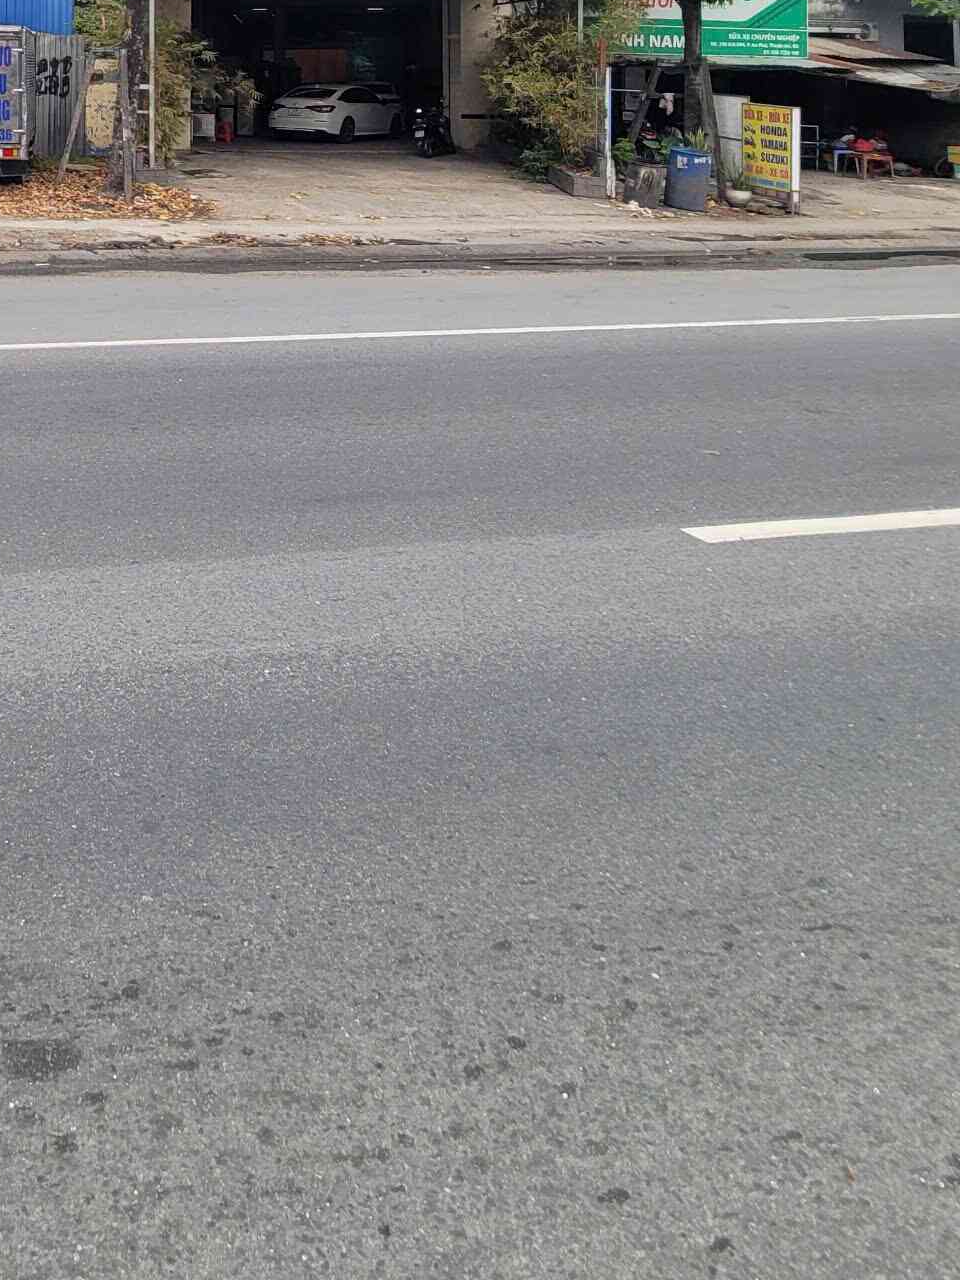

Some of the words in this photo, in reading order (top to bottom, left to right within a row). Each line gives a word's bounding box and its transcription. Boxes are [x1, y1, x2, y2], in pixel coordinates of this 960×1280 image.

[649, 33, 686, 49] NAM
[760, 125, 787, 137] HONDA
[760, 138, 787, 151] YAMAHA
[760, 151, 788, 165] SUZUKI
